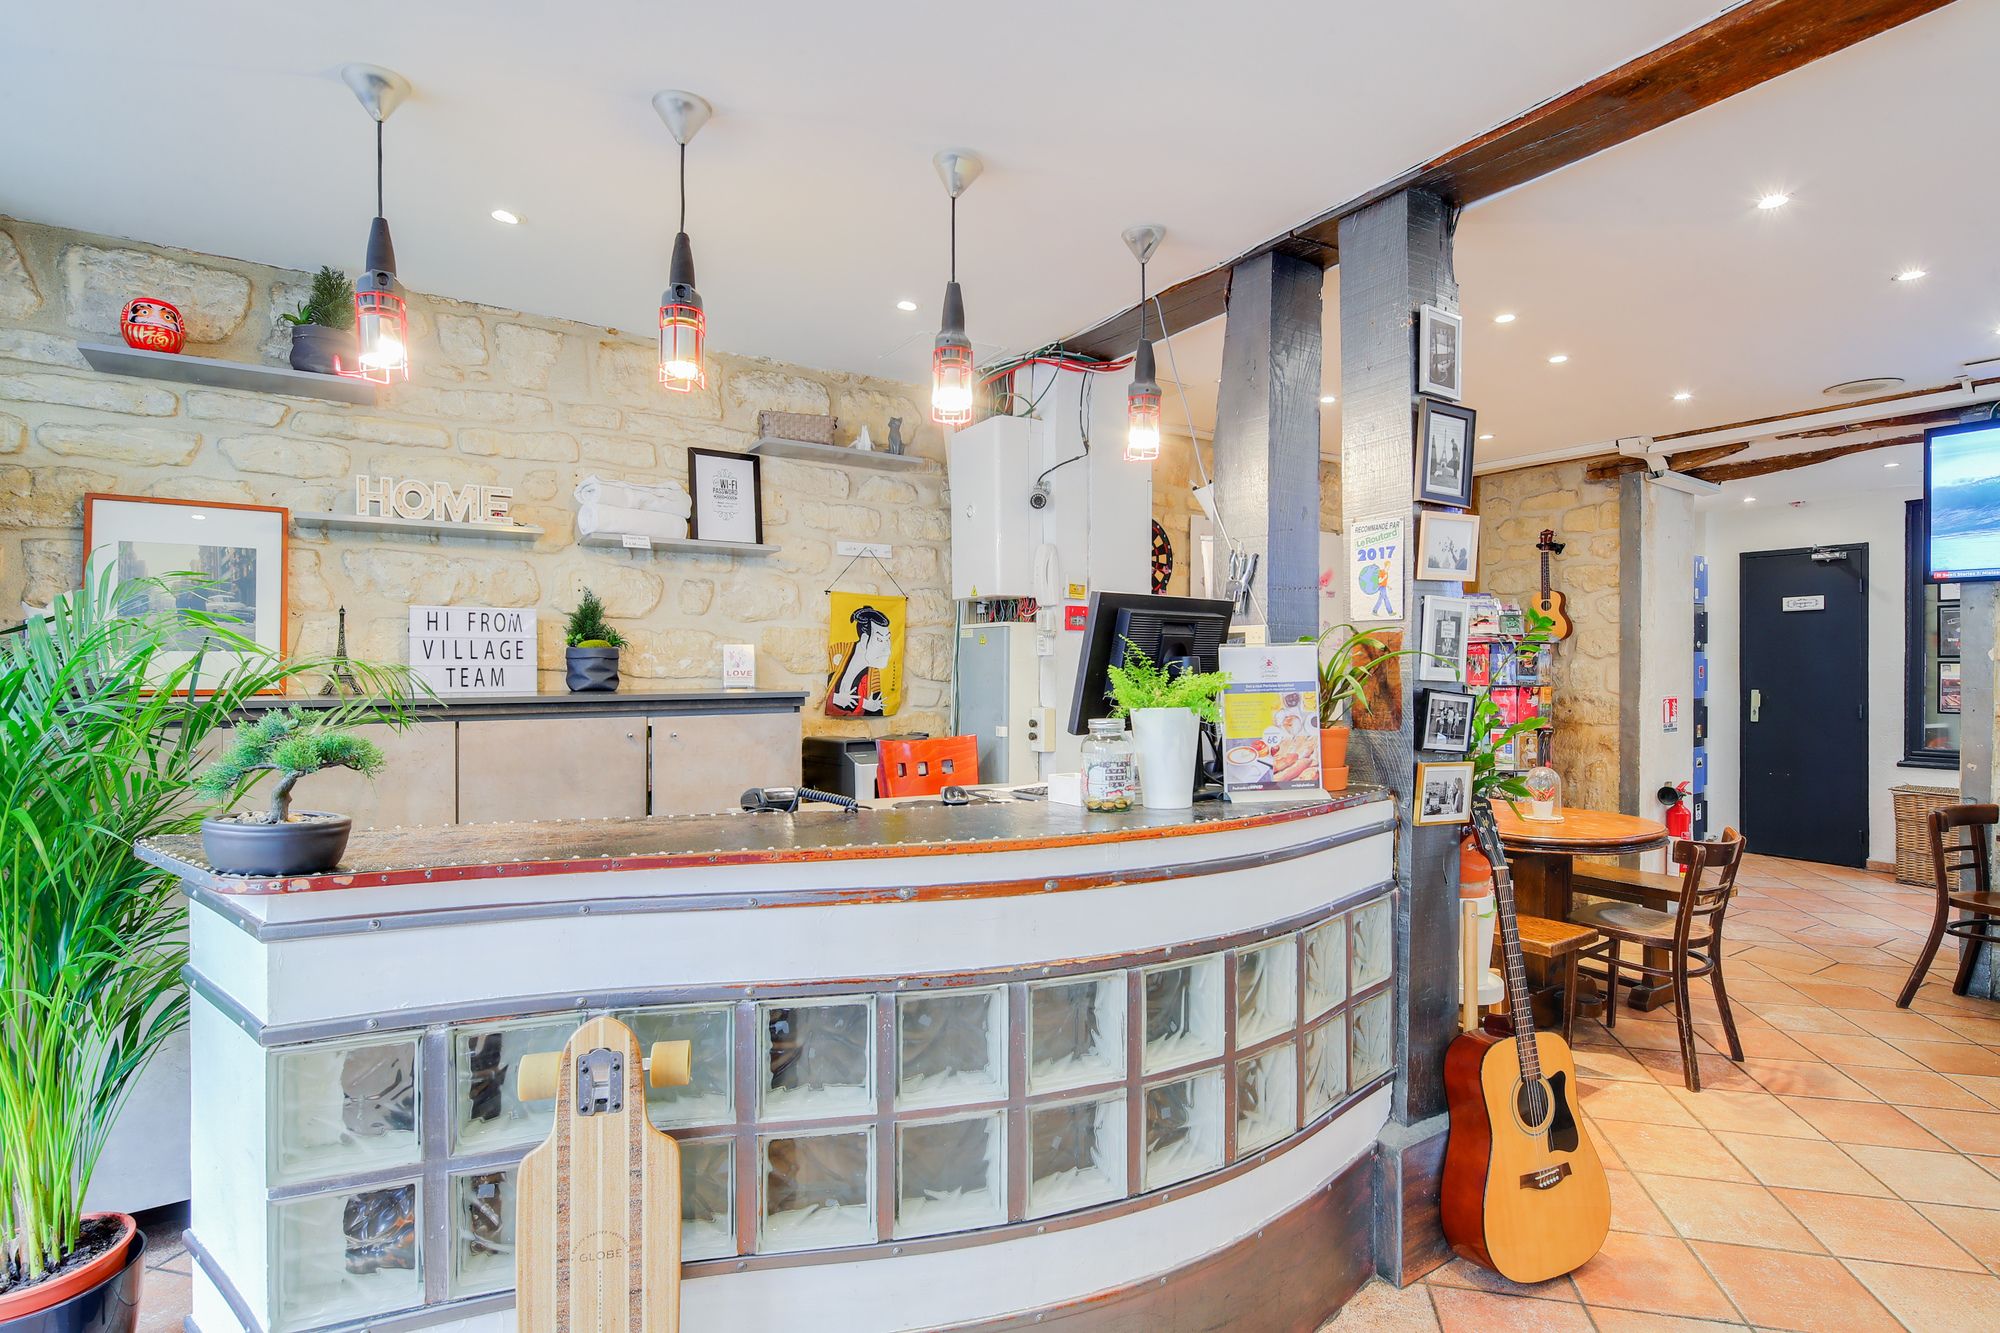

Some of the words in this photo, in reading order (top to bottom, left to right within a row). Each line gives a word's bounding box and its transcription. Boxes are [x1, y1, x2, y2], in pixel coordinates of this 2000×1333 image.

[719, 478, 738, 490] WI-FI
[356, 474, 513, 526] HOME
[1389, 520, 1400, 530] PAR
[1366, 528, 1398, 545] Routard
[1357, 546, 1396, 561] 2017
[427, 611, 449, 632] HI
[468, 612, 523, 632] FROM
[422, 639, 524, 660] VILLAGE
[445, 667, 505, 688] TEAM
[1267, 735, 1278, 744] 6€
[579, 1248, 623, 1263] GLOBE
